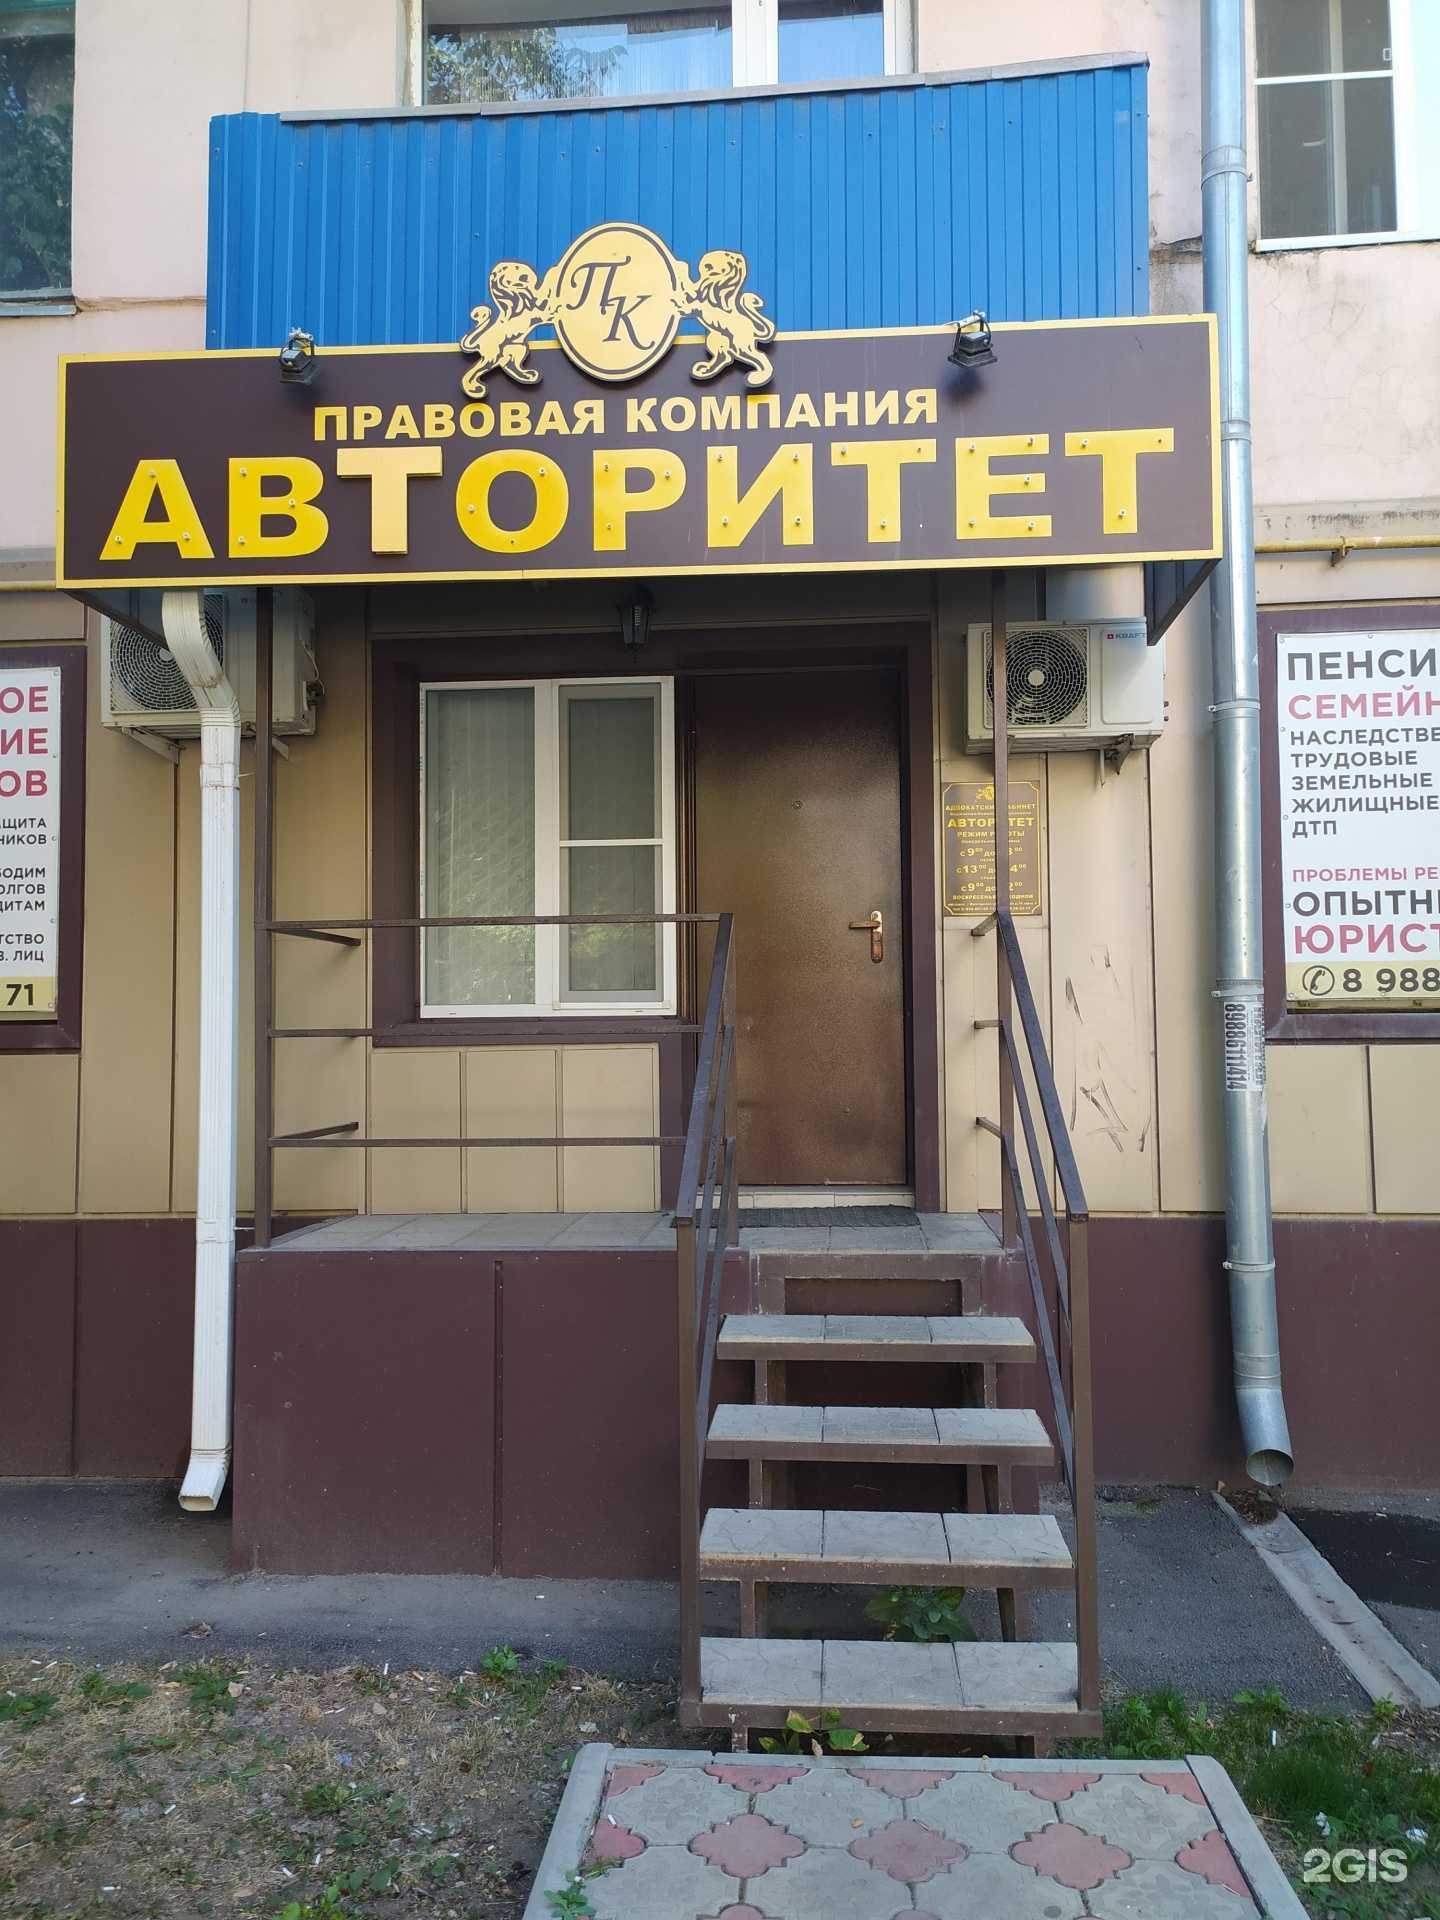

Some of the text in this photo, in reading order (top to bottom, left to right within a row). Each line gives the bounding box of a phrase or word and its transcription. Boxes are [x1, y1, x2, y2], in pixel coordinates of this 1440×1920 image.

[313, 388, 938, 441] ПРАВОВАЯ КОМПАНИЯ
[99, 427, 1174, 561] АВТОРИТЕТ
[1287, 648, 1437, 681] ПЕНСИ
[0, 686, 49, 714] ОЕ
[1288, 684, 1440, 720] СЕМЕЙН
[0, 728, 49, 755] ИЕ
[1290, 727, 1440, 746] НАСЛЕДСТВЕ
[1291, 750, 1418, 769] ТРУДОВЫЕ
[0, 770, 48, 798] ОВ
[1292, 773, 1433, 791] ЗЕМЕЛЬНЫЕ
[1292, 795, 1439, 814] ЖИЛИЩНЫЕ
[0, 817, 47, 830] ЩИТА
[947, 817, 1035, 828] АВТОРТЕТ
[1292, 820, 1337, 838] ДТП
[0, 867, 46, 880] ОДИМ
[1292, 866, 1439, 883] ПРОБЛЕМЫ РЕ
[1292, 889, 1440, 917] ОПЫТН
[13, 950, 44, 963] ЛИЦ
[1343, 967, 1440, 993] 8 988
[6, 983, 34, 1006] 71
[1225, 1003, 1247, 1090] 89886111414
